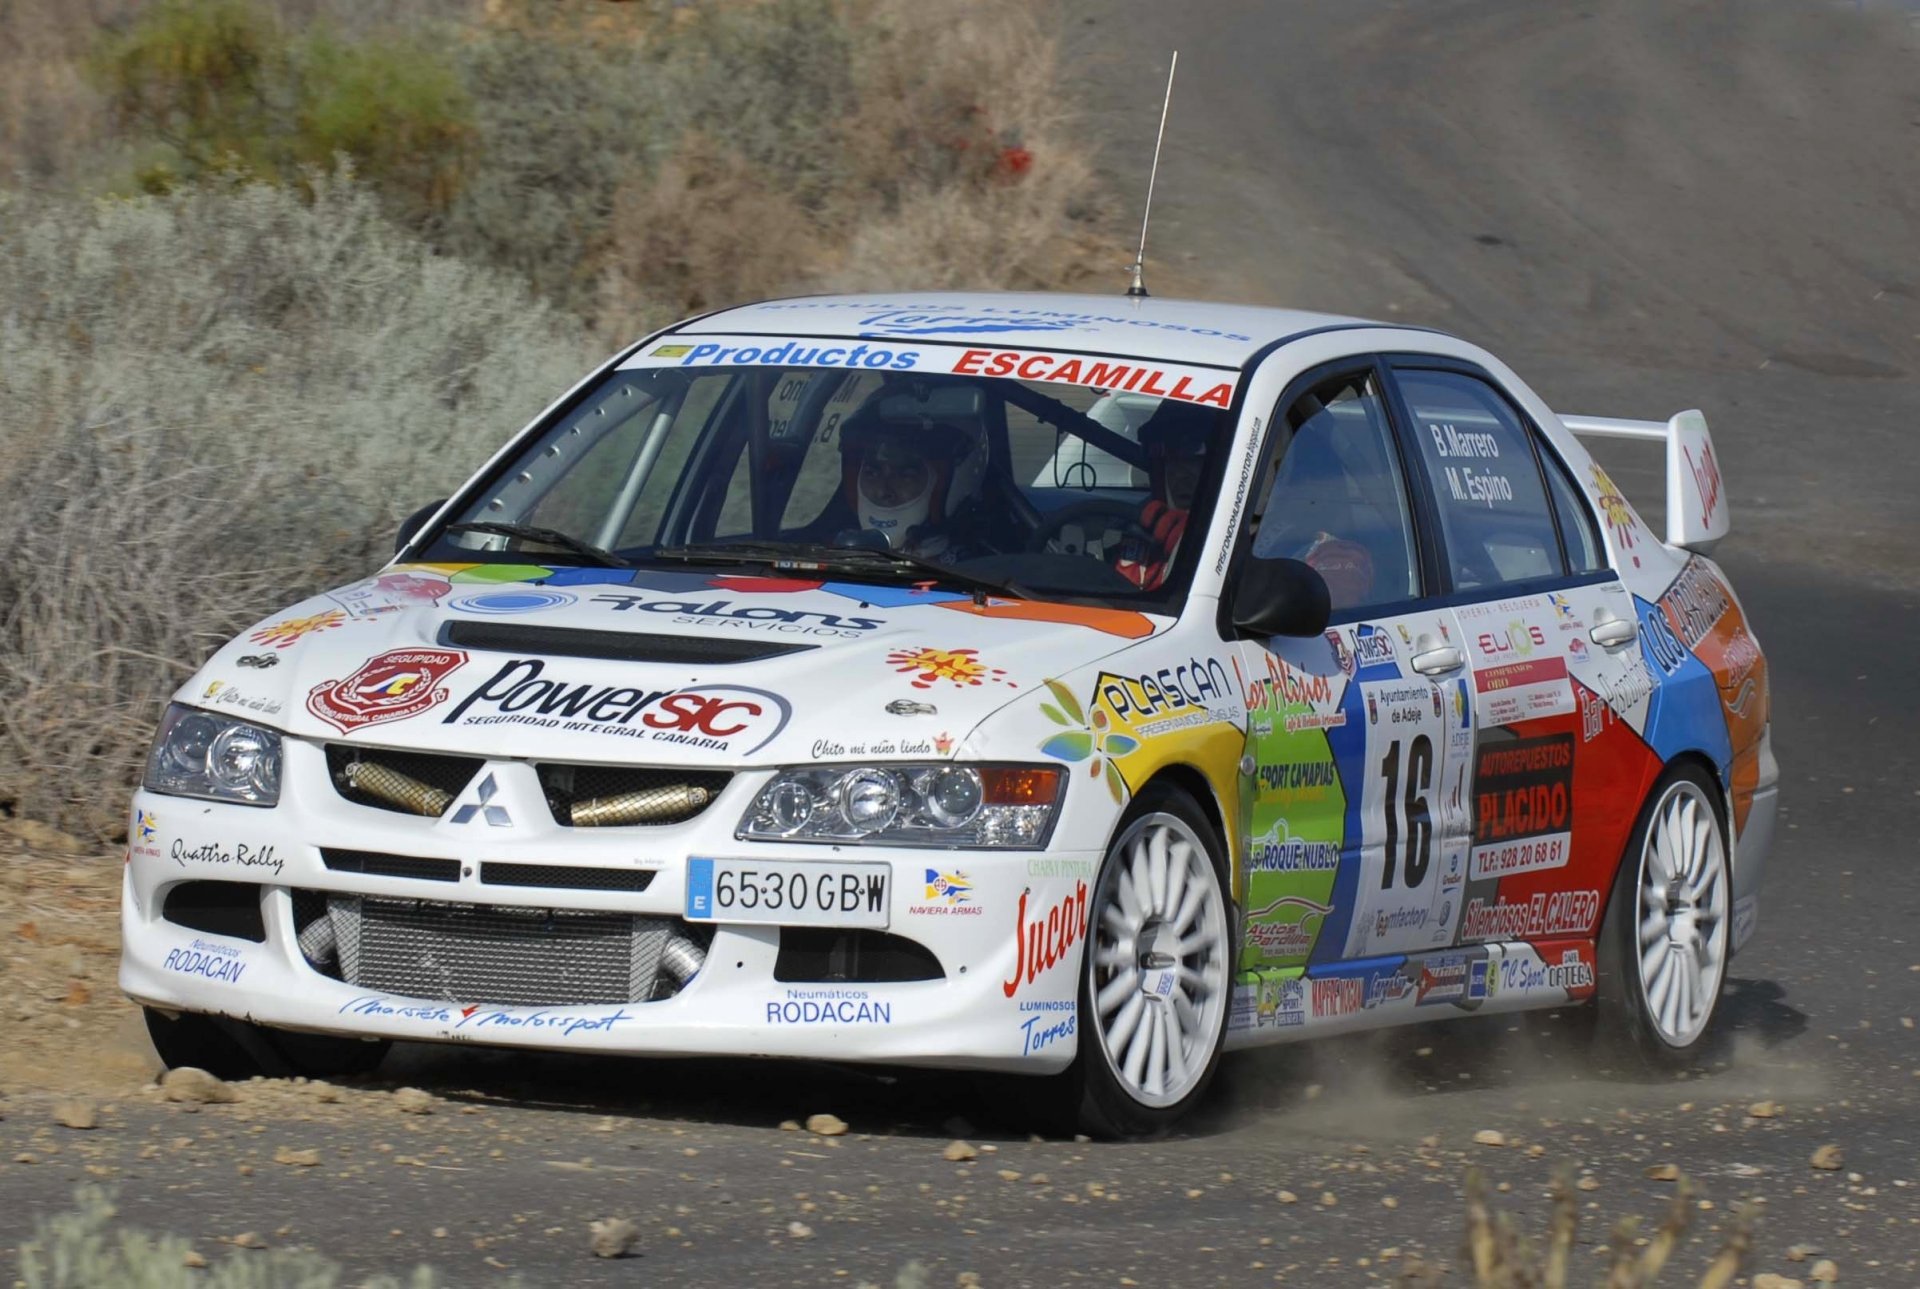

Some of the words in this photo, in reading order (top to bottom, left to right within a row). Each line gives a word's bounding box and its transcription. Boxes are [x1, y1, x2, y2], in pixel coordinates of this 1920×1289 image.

[982, 307, 1251, 341] LUMINOSOS
[681, 343, 920, 369] Productos
[952, 350, 1233, 408] ESCAMILLA
[1445, 467, 1468, 500] M.
[1463, 468, 1512, 508] Espino
[672, 616, 863, 640] SERVICIOS
[384, 655, 450, 665] SEGURIDAD
[1485, 664, 1533, 677] COMPRAMOS
[1380, 686, 1428, 706] Ayuntamiento
[1487, 679, 1509, 690] ORO
[335, 713, 369, 722] INTEGRAL
[372, 710, 410, 721] CANARIA
[1392, 709, 1401, 723] de
[1402, 707, 1422, 725] Adeje
[464, 716, 558, 729] SEGURIDAD
[563, 722, 645, 740] INTEGRAL
[649, 731, 728, 751] CANARIA
[812, 740, 845, 758] Chito
[850, 743, 866, 755] mi
[871, 740, 895, 755] niño
[900, 739, 931, 755] lindo
[1480, 742, 1570, 776] AUTOREPUESTOS
[1381, 734, 1433, 889] 16
[1479, 781, 1567, 839] PLACIDO
[171, 838, 230, 867] Quattro
[237, 844, 285, 875] Rally
[1262, 844, 1301, 869] ROQUE
[1303, 844, 1338, 869] NUBLO
[1500, 848, 1517, 869] 928
[1519, 845, 1533, 865] 20
[1535, 843, 1548, 863] 68
[1550, 840, 1563, 861] 61
[694, 896, 706, 910] E
[717, 871, 808, 910] 6530
[817, 873, 885, 912] GBW
[909, 906, 948, 915] NAVIERA
[952, 906, 983, 916] ARMAS
[1527, 894, 1545, 934] EL
[1545, 892, 1598, 933] CALERO
[164, 949, 246, 983] RODACAN
[787, 989, 869, 999] Neumáticos
[1019, 1001, 1076, 1012] LUMINOSOS
[767, 1002, 891, 1023] RODACAN
[1021, 1016, 1076, 1056] Torres
